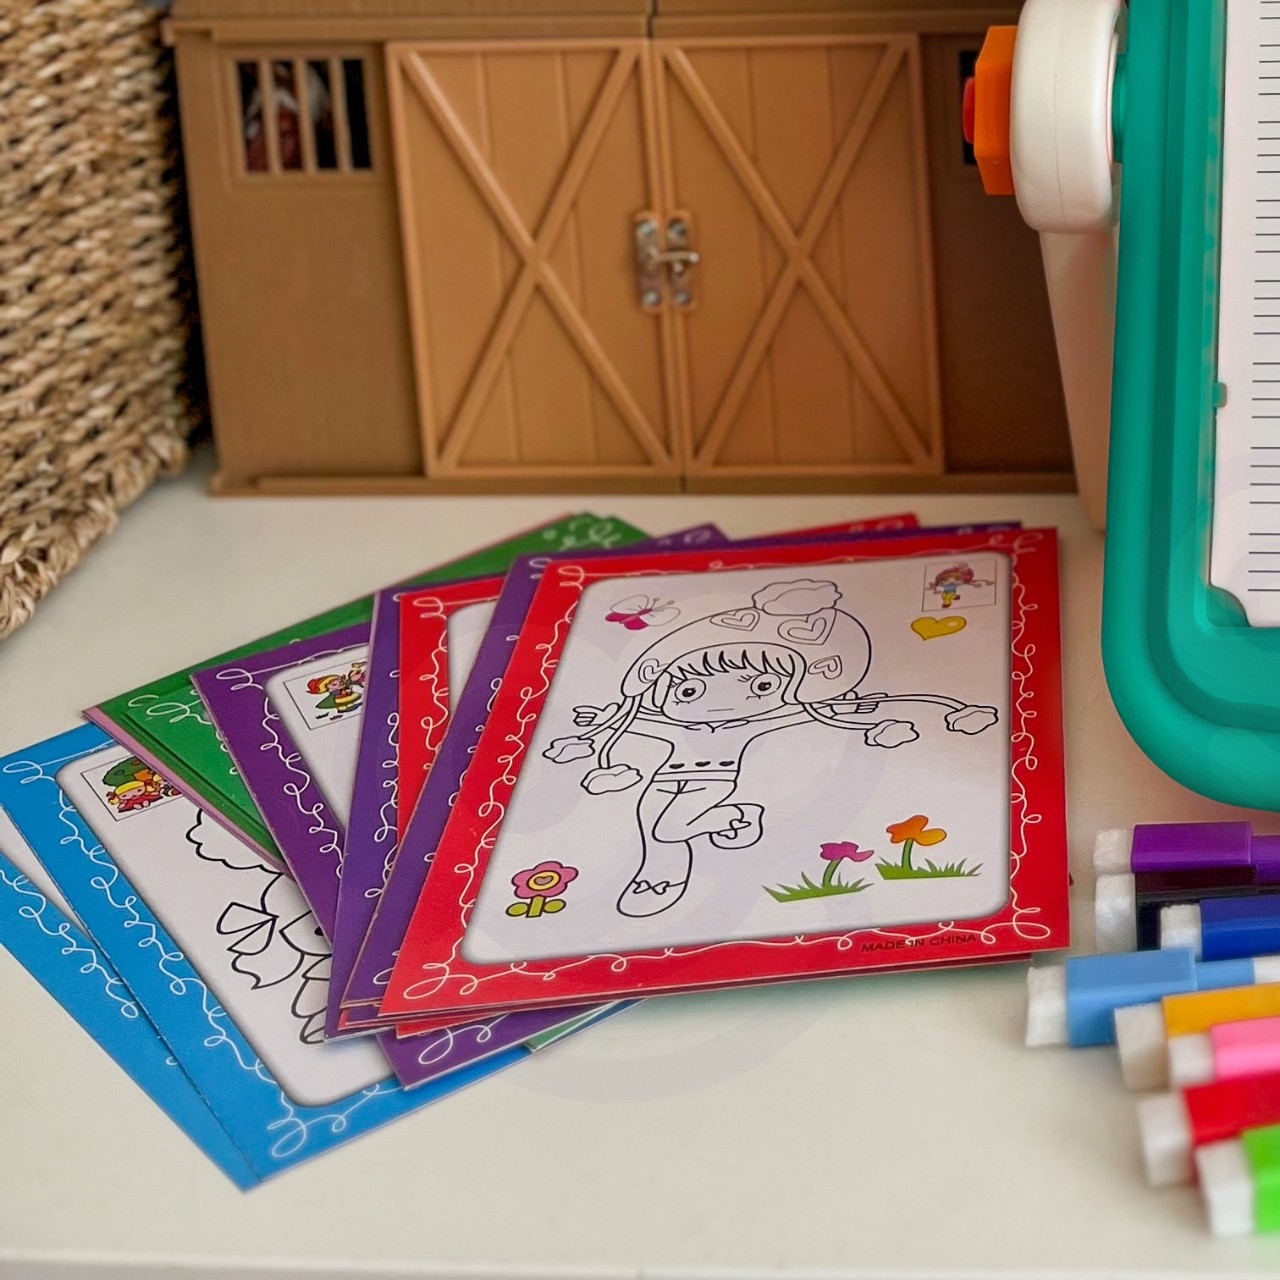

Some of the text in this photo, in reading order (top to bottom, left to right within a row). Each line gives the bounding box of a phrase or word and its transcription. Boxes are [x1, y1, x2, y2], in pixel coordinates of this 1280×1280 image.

[861, 934, 977, 952] MADE IN CHINA
